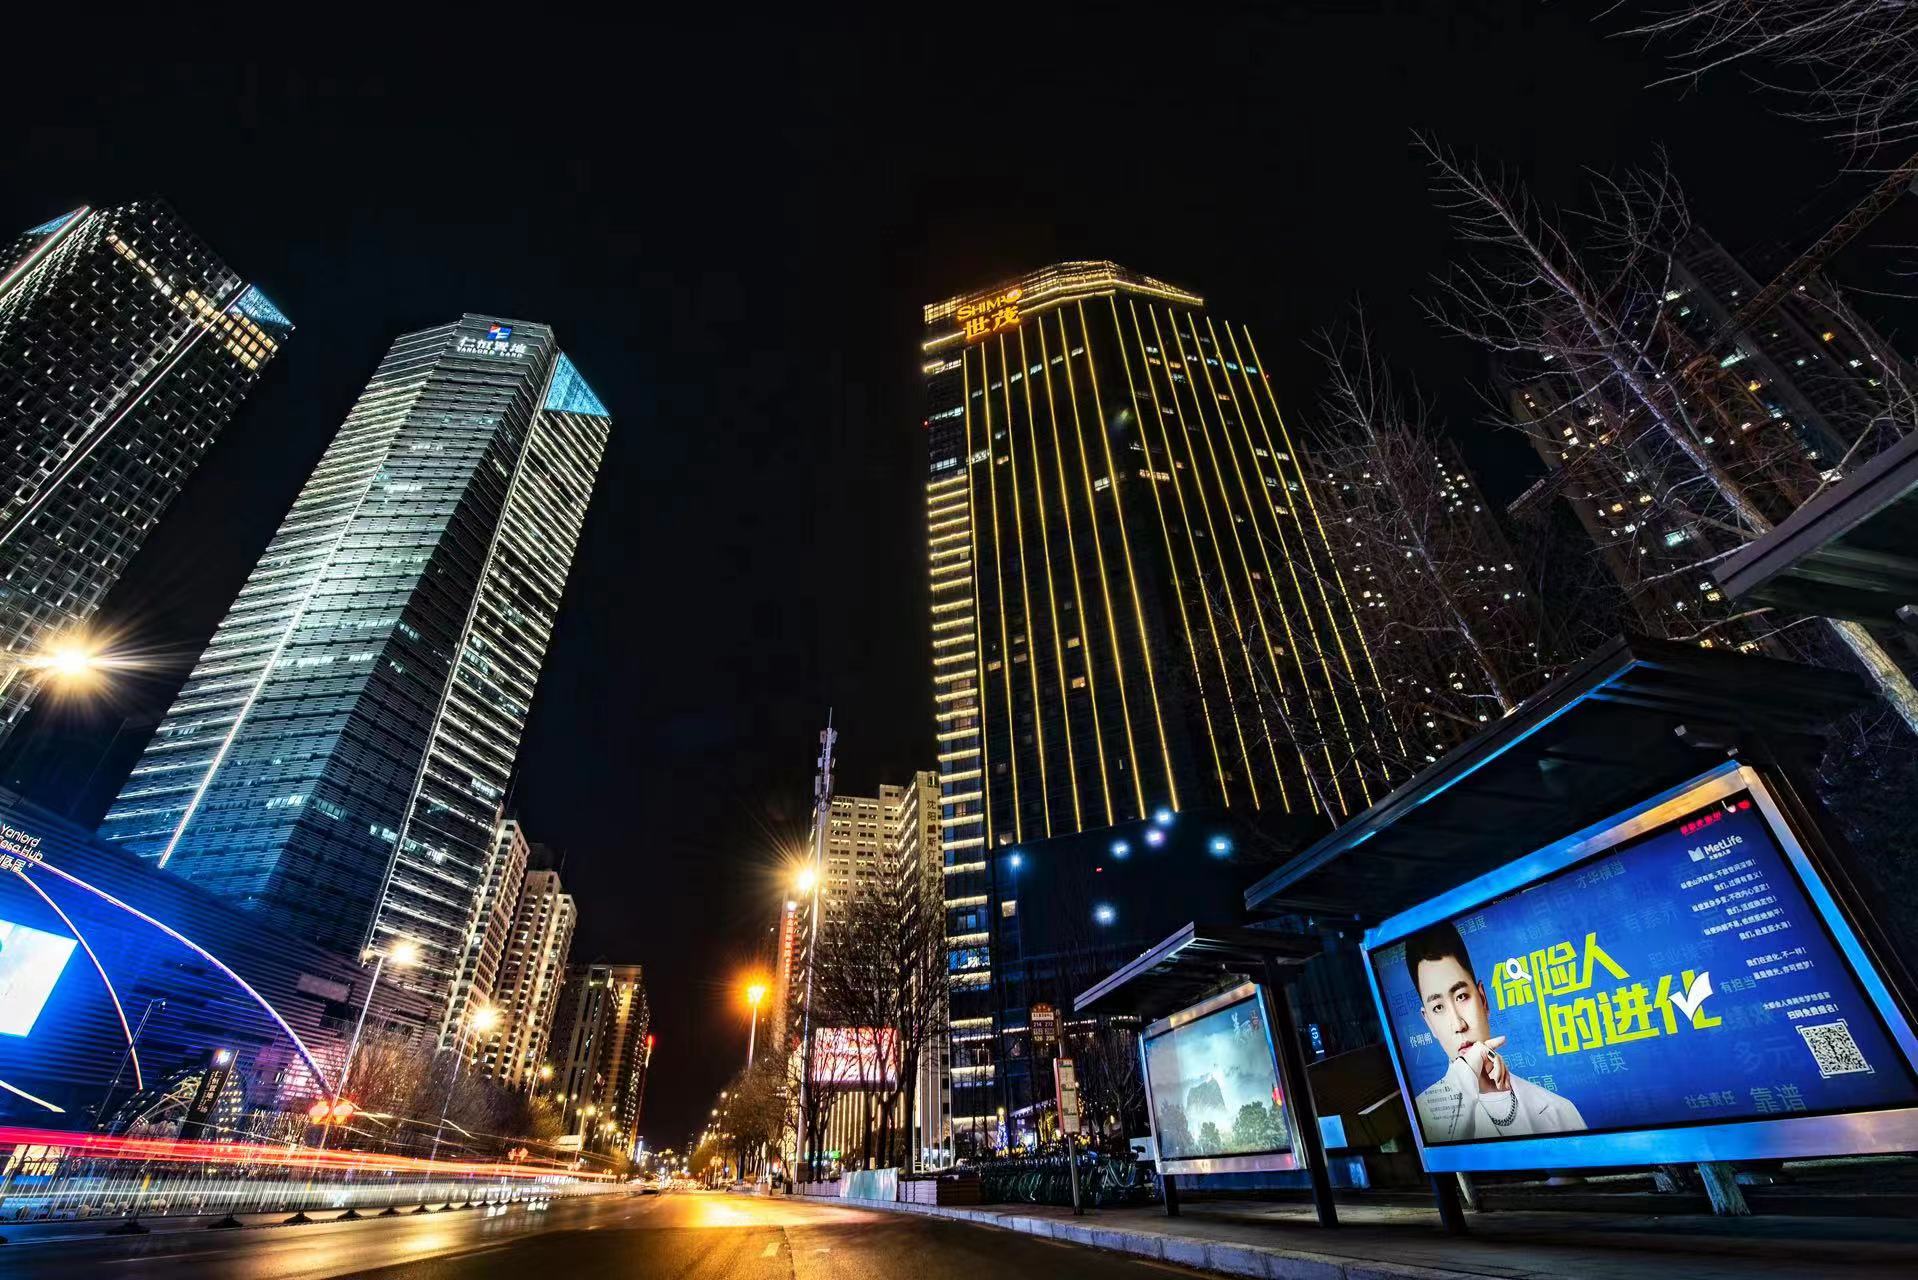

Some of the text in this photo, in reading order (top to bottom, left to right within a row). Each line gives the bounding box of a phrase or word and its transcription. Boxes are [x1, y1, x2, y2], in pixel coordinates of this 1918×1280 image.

[963, 306, 1020, 340] 世茂
[1, 823, 41, 847] Yanlord
[1703, 835, 1743, 855] MetLife
[20, 845, 43, 861] Hub
[1491, 932, 1630, 1014] 保险人
[1720, 975, 1757, 993] 有担当
[1547, 969, 1722, 1055] 的进化
[1590, 1049, 1629, 1075] 精英
[1684, 1090, 1737, 1109] 社会责任
[1750, 1083, 1807, 1113] 靠谱
